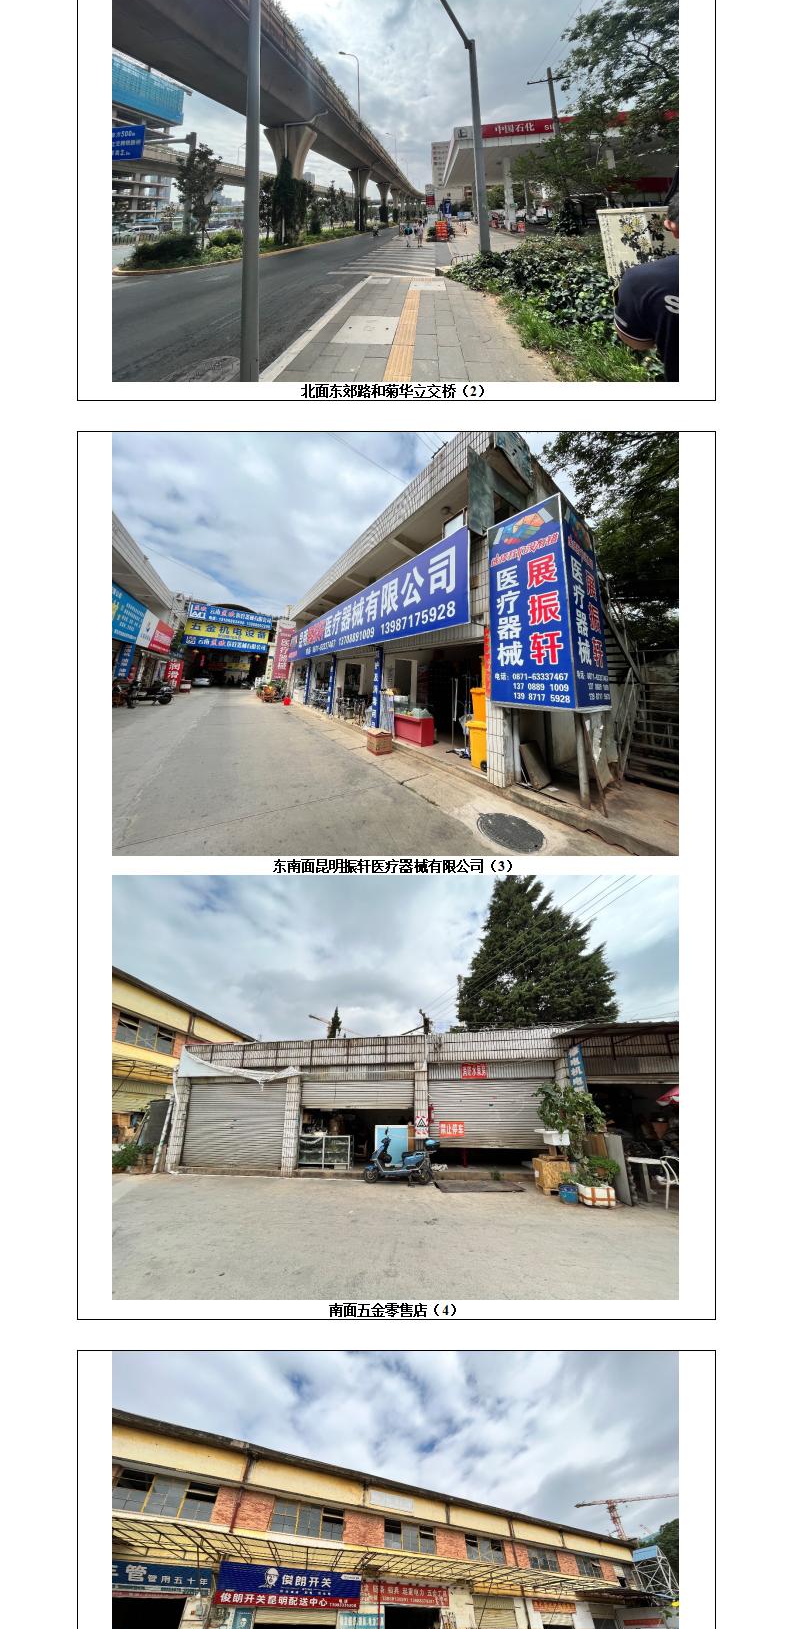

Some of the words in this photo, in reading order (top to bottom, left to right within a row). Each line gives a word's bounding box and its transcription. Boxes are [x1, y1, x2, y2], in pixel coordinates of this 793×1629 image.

[494, 122, 535, 134] 中国石化
[301, 384, 484, 400] 北面东郊路和菊华立交桥（2）
[496, 565, 524, 667] 医疗器械
[526, 553, 563, 665] 展振轩
[571, 556, 591, 666] 医疗器械
[381, 601, 456, 636] 13987175928
[513, 682, 525, 690] 137
[527, 682, 545, 691] 0889
[550, 683, 569, 692] 1009
[514, 692, 525, 700] 139
[528, 693, 546, 702] 8717
[550, 694, 571, 703] 5928
[273, 859, 512, 875] 东南面昆明振轩医疗器械有限公司（3）
[440, 1123, 464, 1136] 禁止停车
[329, 1303, 456, 1319] 南面五金零售店（4）
[282, 1574, 332, 1588] 俊朗开关
[220, 1592, 328, 1607] 俊朗开关昆明配送中心
